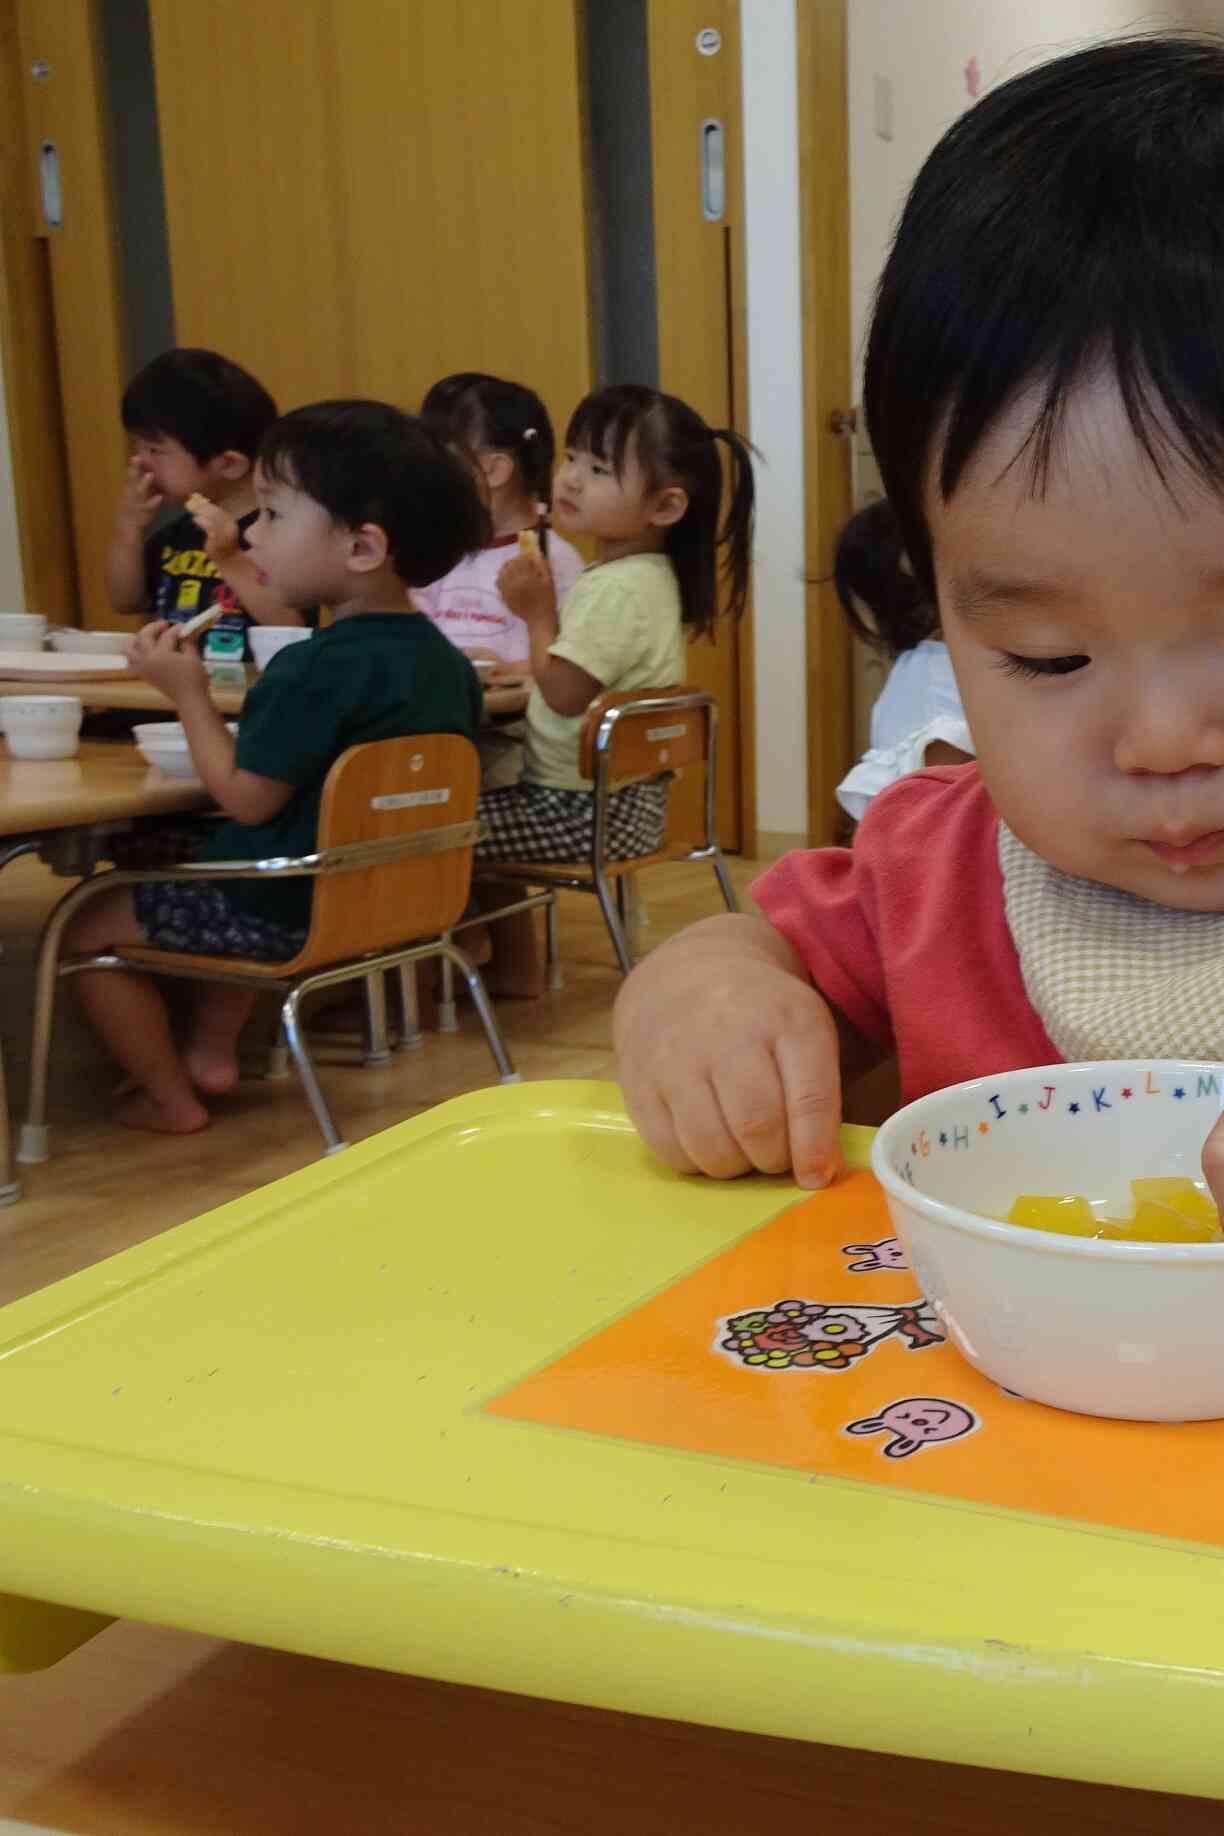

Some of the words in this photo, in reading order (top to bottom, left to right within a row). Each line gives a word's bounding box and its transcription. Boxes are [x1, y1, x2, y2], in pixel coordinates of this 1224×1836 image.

[953, 1125, 969, 1151] H
[988, 1094, 1007, 1119] I
[1038, 1086, 1056, 1112] J
[1092, 1087, 1113, 1112] K
[1144, 1071, 1161, 1096] L
[1196, 1075, 1220, 1098] M
